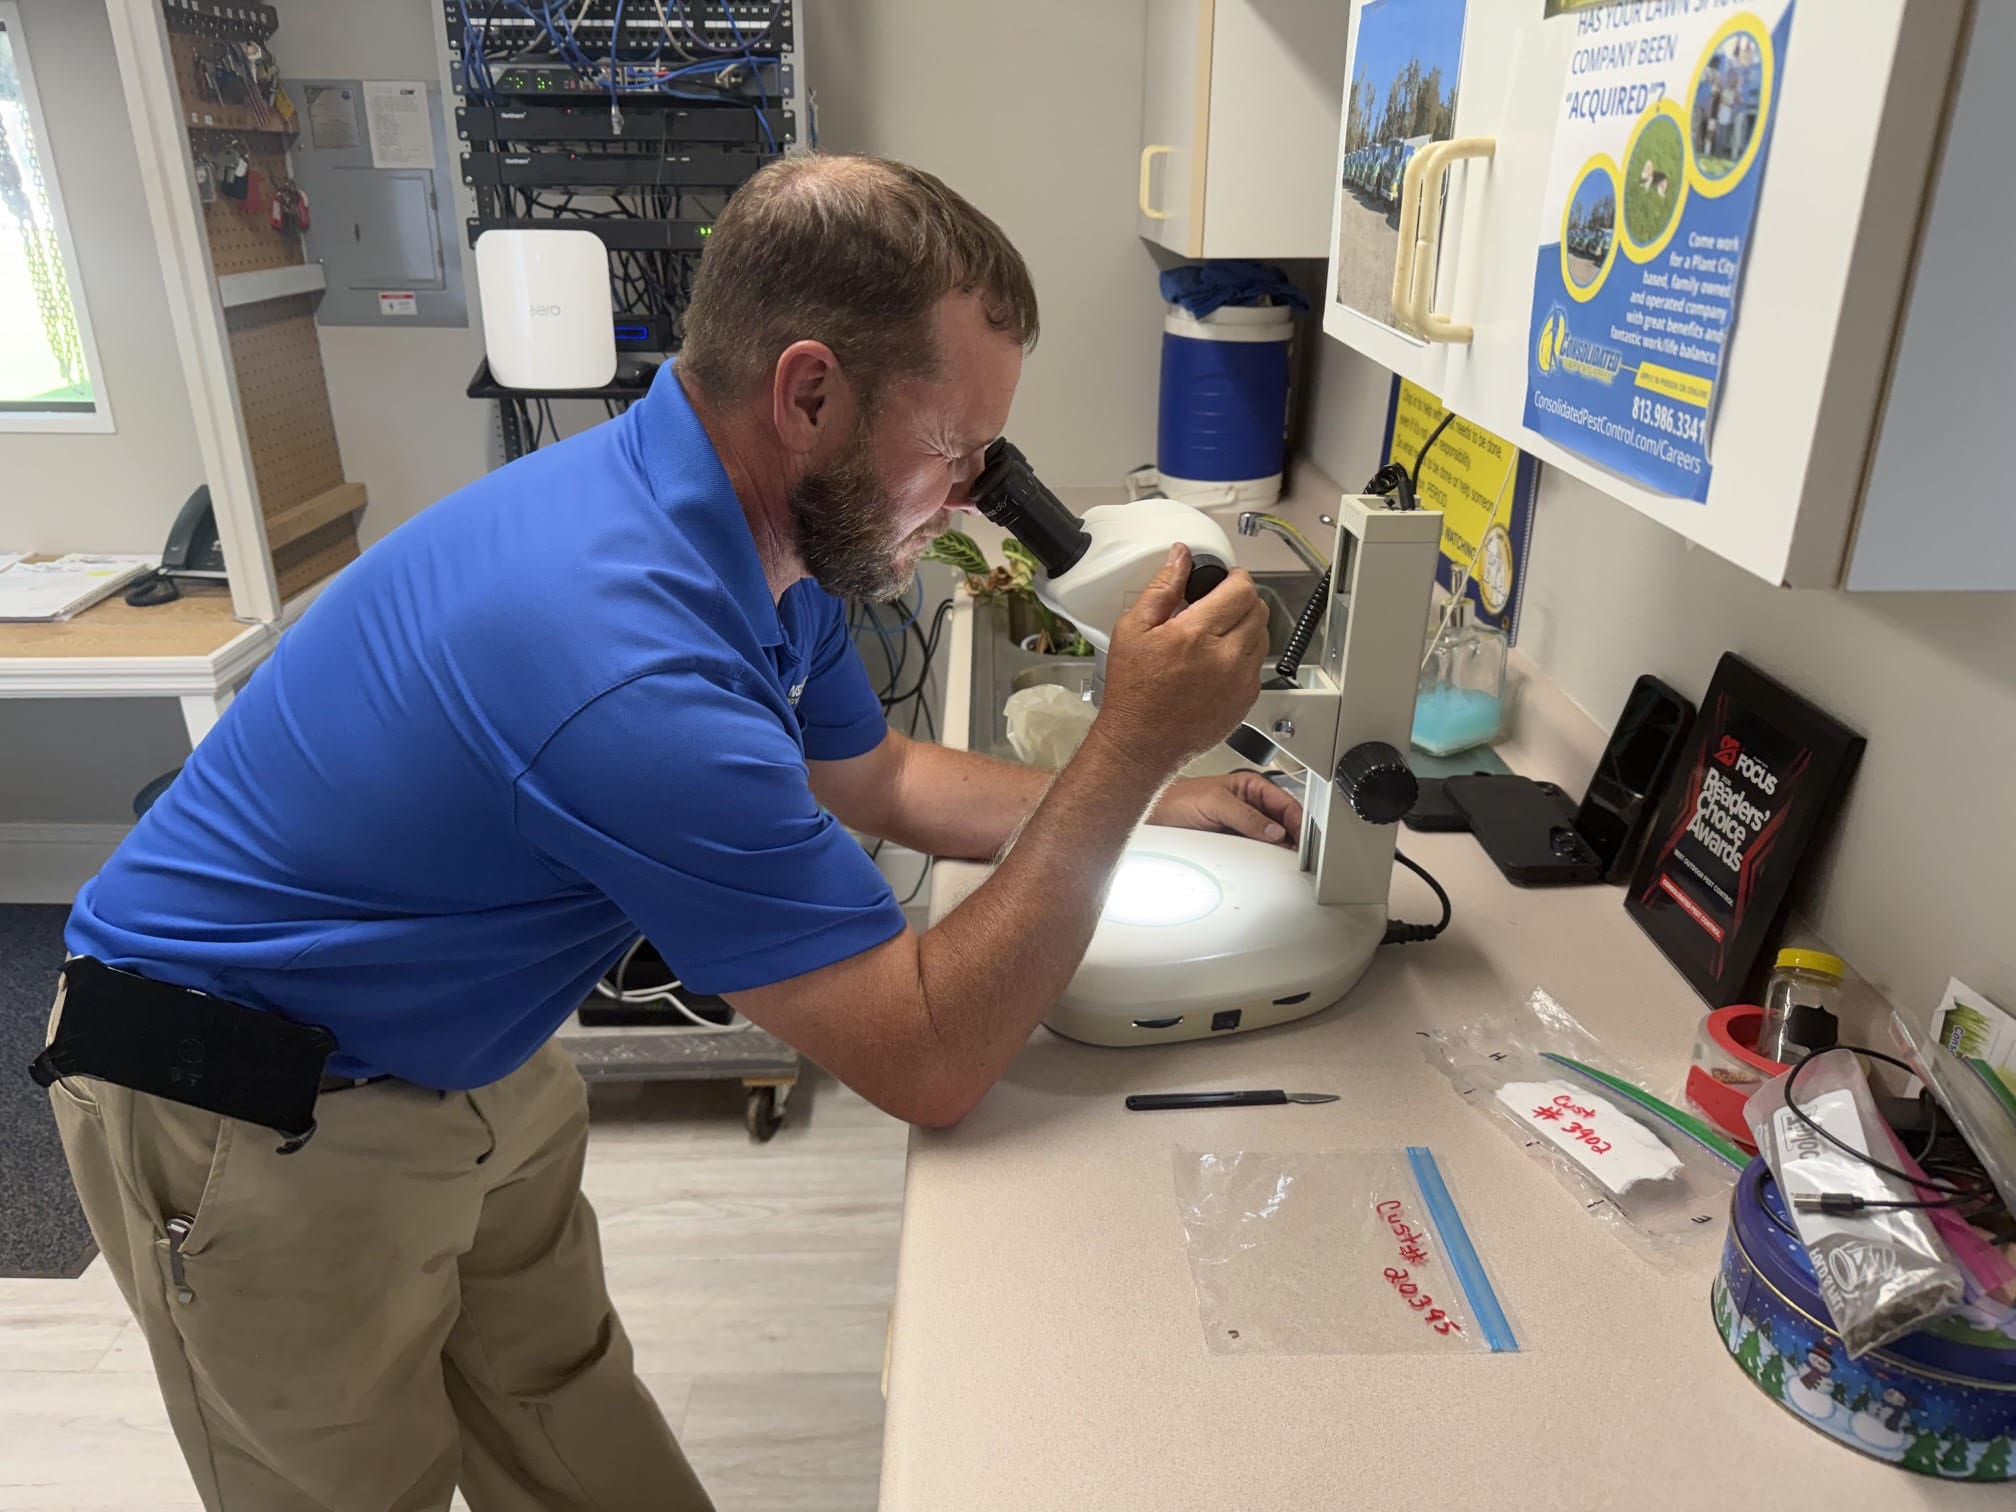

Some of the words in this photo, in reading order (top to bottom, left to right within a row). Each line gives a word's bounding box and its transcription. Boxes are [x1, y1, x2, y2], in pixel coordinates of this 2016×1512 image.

[1577, 8, 1601, 36] HAS
[1571, 43, 1637, 74] COMPANY
[1637, 34, 1679, 65] BEEN
[1688, 231, 1715, 249] Come
[1716, 235, 1739, 251] work
[1669, 251, 1683, 268] for
[1684, 256, 1691, 269] a
[1691, 254, 1717, 273] Plant
[1718, 258, 1736, 280] City
[1642, 269, 1668, 290] based,
[1670, 273, 1699, 296] family
[1701, 281, 1732, 298] owned
[1629, 291, 1646, 305] and
[1646, 295, 1685, 312] operated
[1685, 301, 1728, 325] company
[1609, 324, 1642, 347] fantastic
[1625, 309, 1643, 325] with
[1643, 315, 1666, 331] great
[1666, 317, 1704, 339] benefits
[1704, 327, 1726, 344] and
[1534, 390, 1702, 475] ConsolidatedPestControl.com/Careers
[1632, 396, 1705, 444] 813.986.3341
[1735, 753, 1778, 795] FOCUS
[1697, 790, 1746, 841] Choice
[1703, 767, 1770, 831] Readers'
[1686, 812, 1744, 872] Awards
[1702, 874, 1715, 889] PEST
[1713, 885, 1734, 907] CONTROL
[1690, 904, 1702, 919] PEST
[1700, 915, 1721, 938] CONTROL
[1552, 1095, 1596, 1119] Cust
[1531, 1105, 1565, 1121] #
[1561, 1121, 1612, 1154] 3902
[1383, 1266, 1461, 1336] 20395
